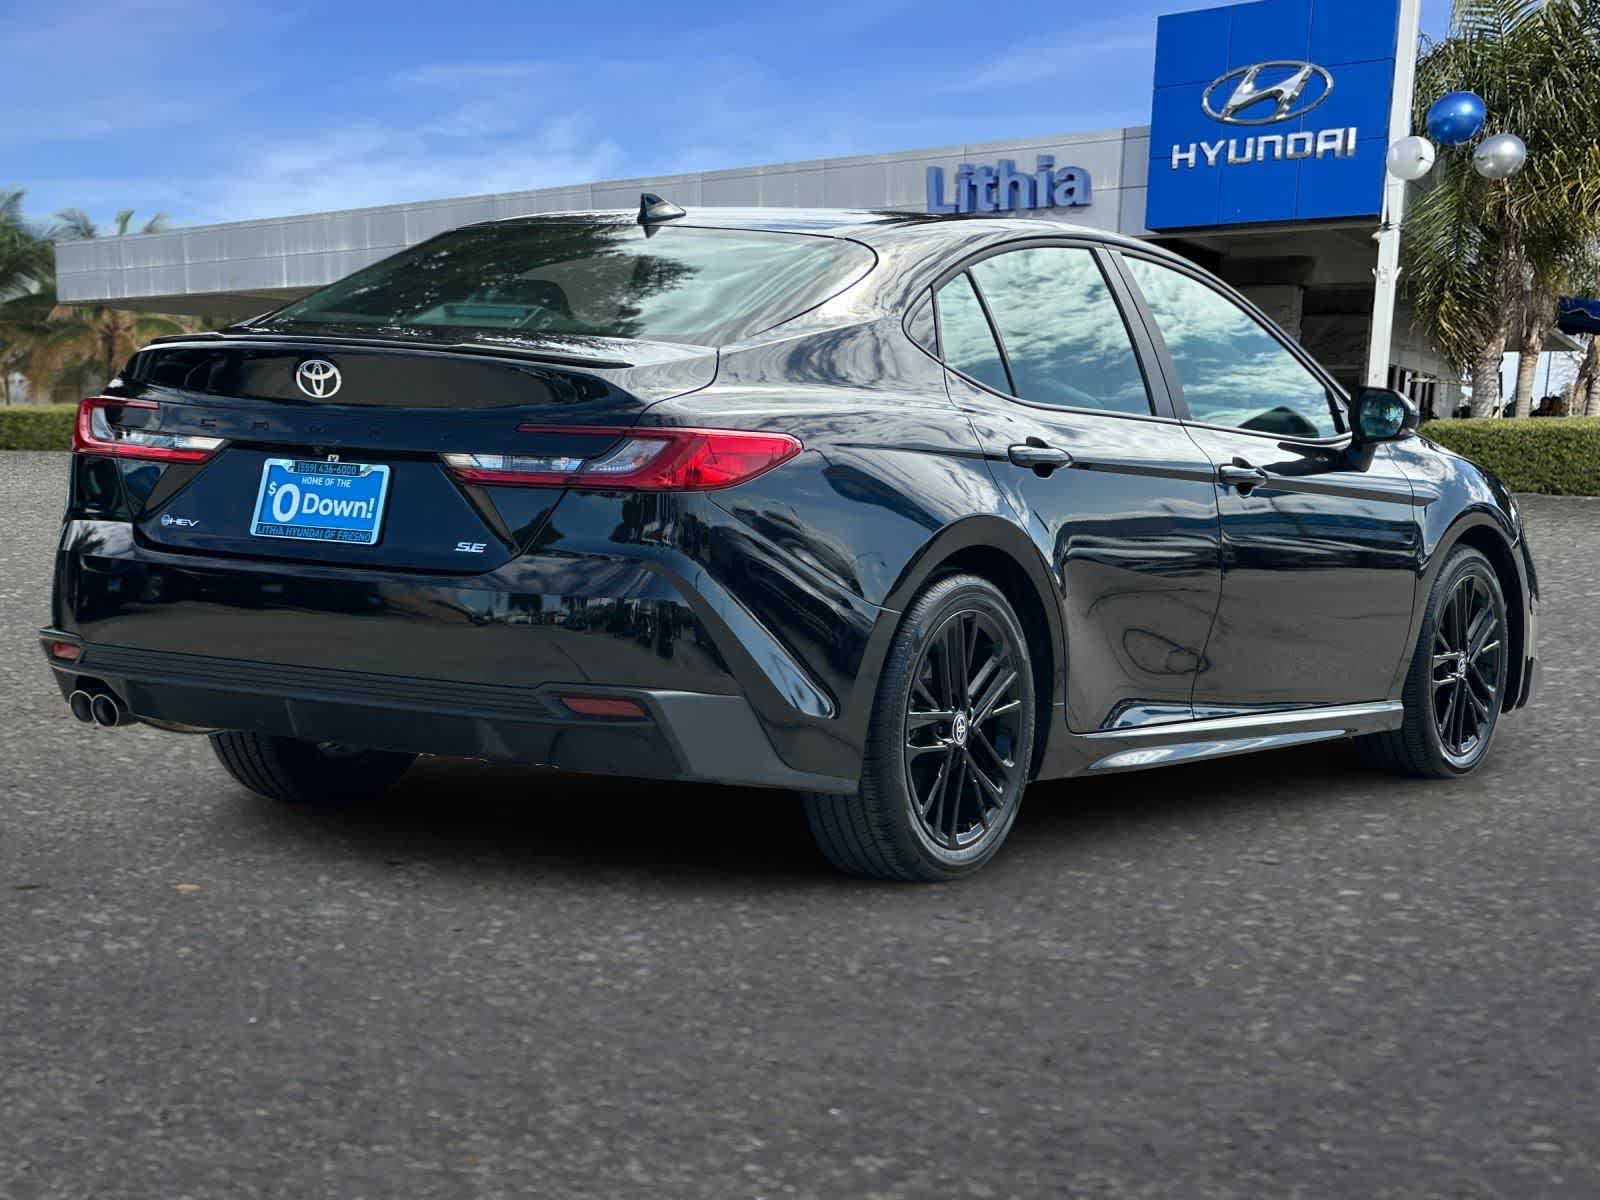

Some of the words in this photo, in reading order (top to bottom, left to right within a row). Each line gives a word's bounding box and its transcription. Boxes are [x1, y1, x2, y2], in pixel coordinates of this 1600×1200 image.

[1171, 127, 1357, 169] HYUNDAI
[926, 154, 1092, 213] Lithia
[301, 476, 323, 486] HOME
[324, 478, 335, 487] OF
[336, 479, 352, 488] THE
[301, 493, 375, 519] Down!
[169, 517, 200, 527] HEV
[285, 527, 323, 538] HYUNDAI
[324, 530, 336, 539] OF
[337, 531, 371, 542] FRESNO
[455, 541, 488, 553] SE
